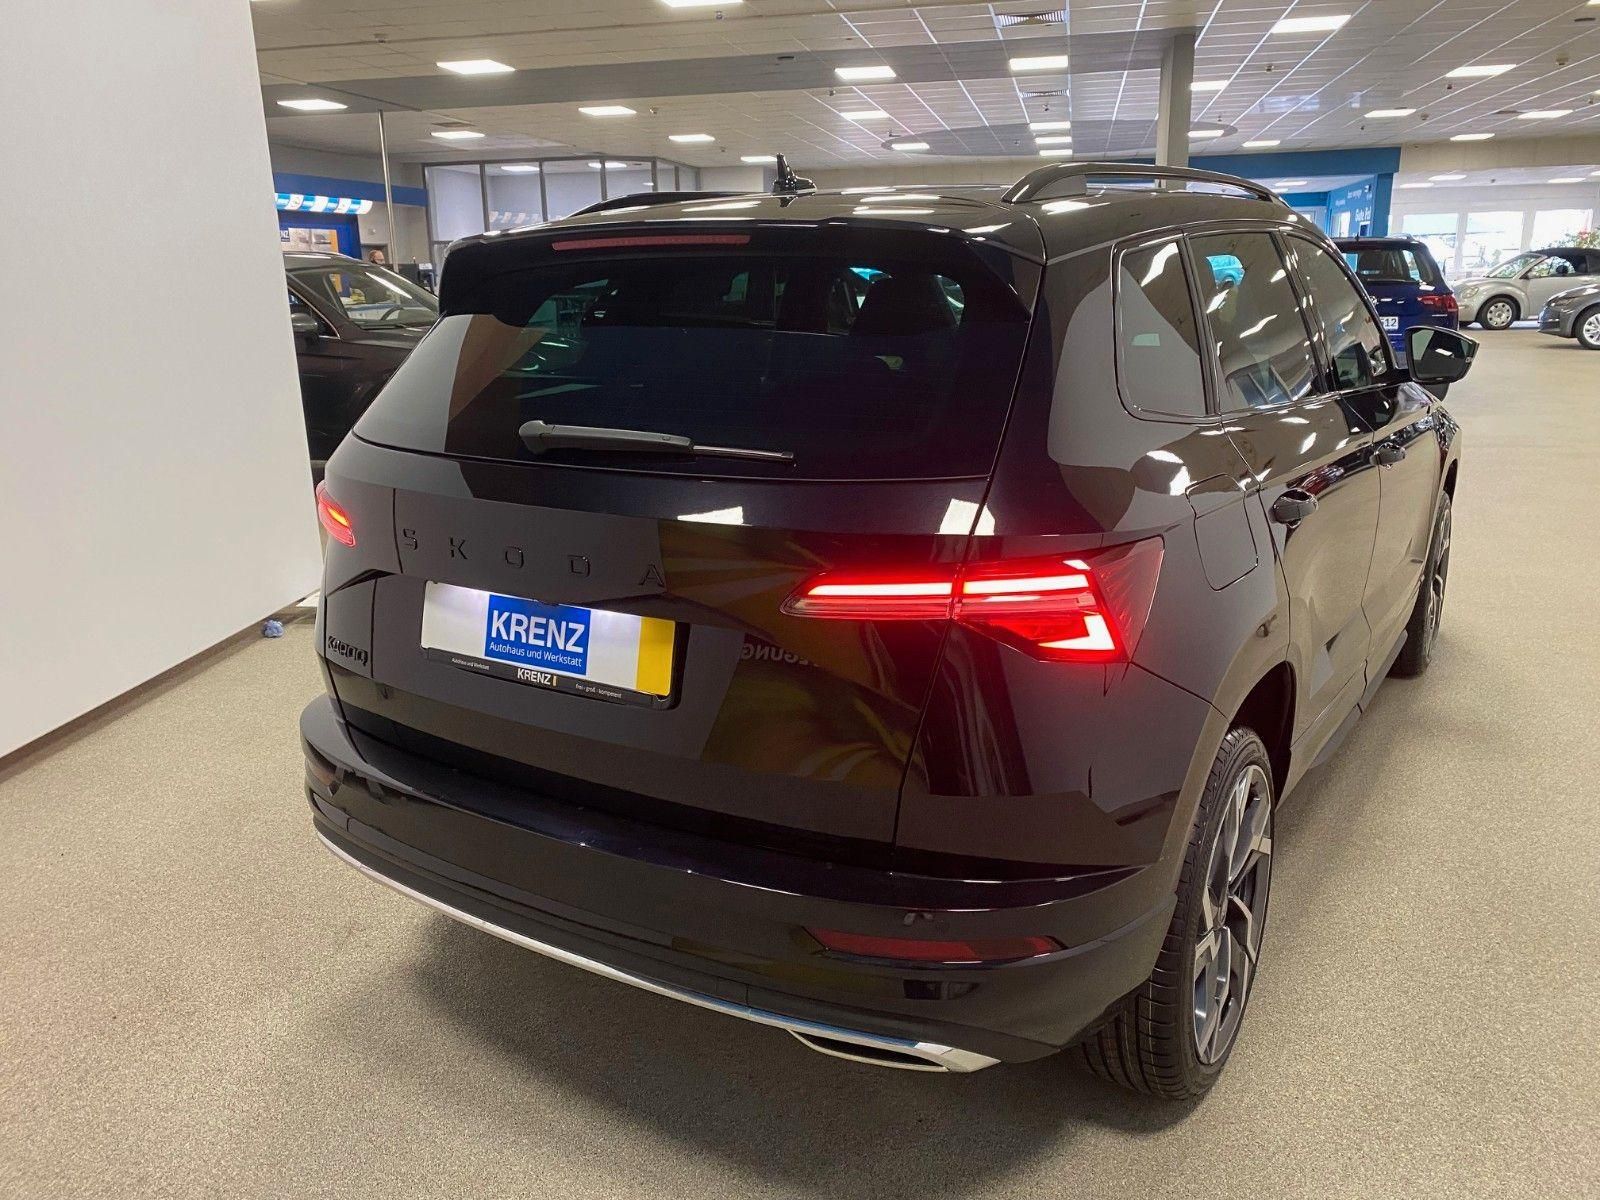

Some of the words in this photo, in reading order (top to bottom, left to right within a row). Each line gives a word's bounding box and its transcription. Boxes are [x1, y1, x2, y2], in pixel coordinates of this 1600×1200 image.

[402, 528, 666, 588] SKODA
[491, 610, 585, 653] KRENZ
[489, 642, 525, 656] Autohaus
[526, 650, 542, 659] und
[543, 652, 582, 667] Werkstatt
[517, 667, 551, 685] KRENZ
